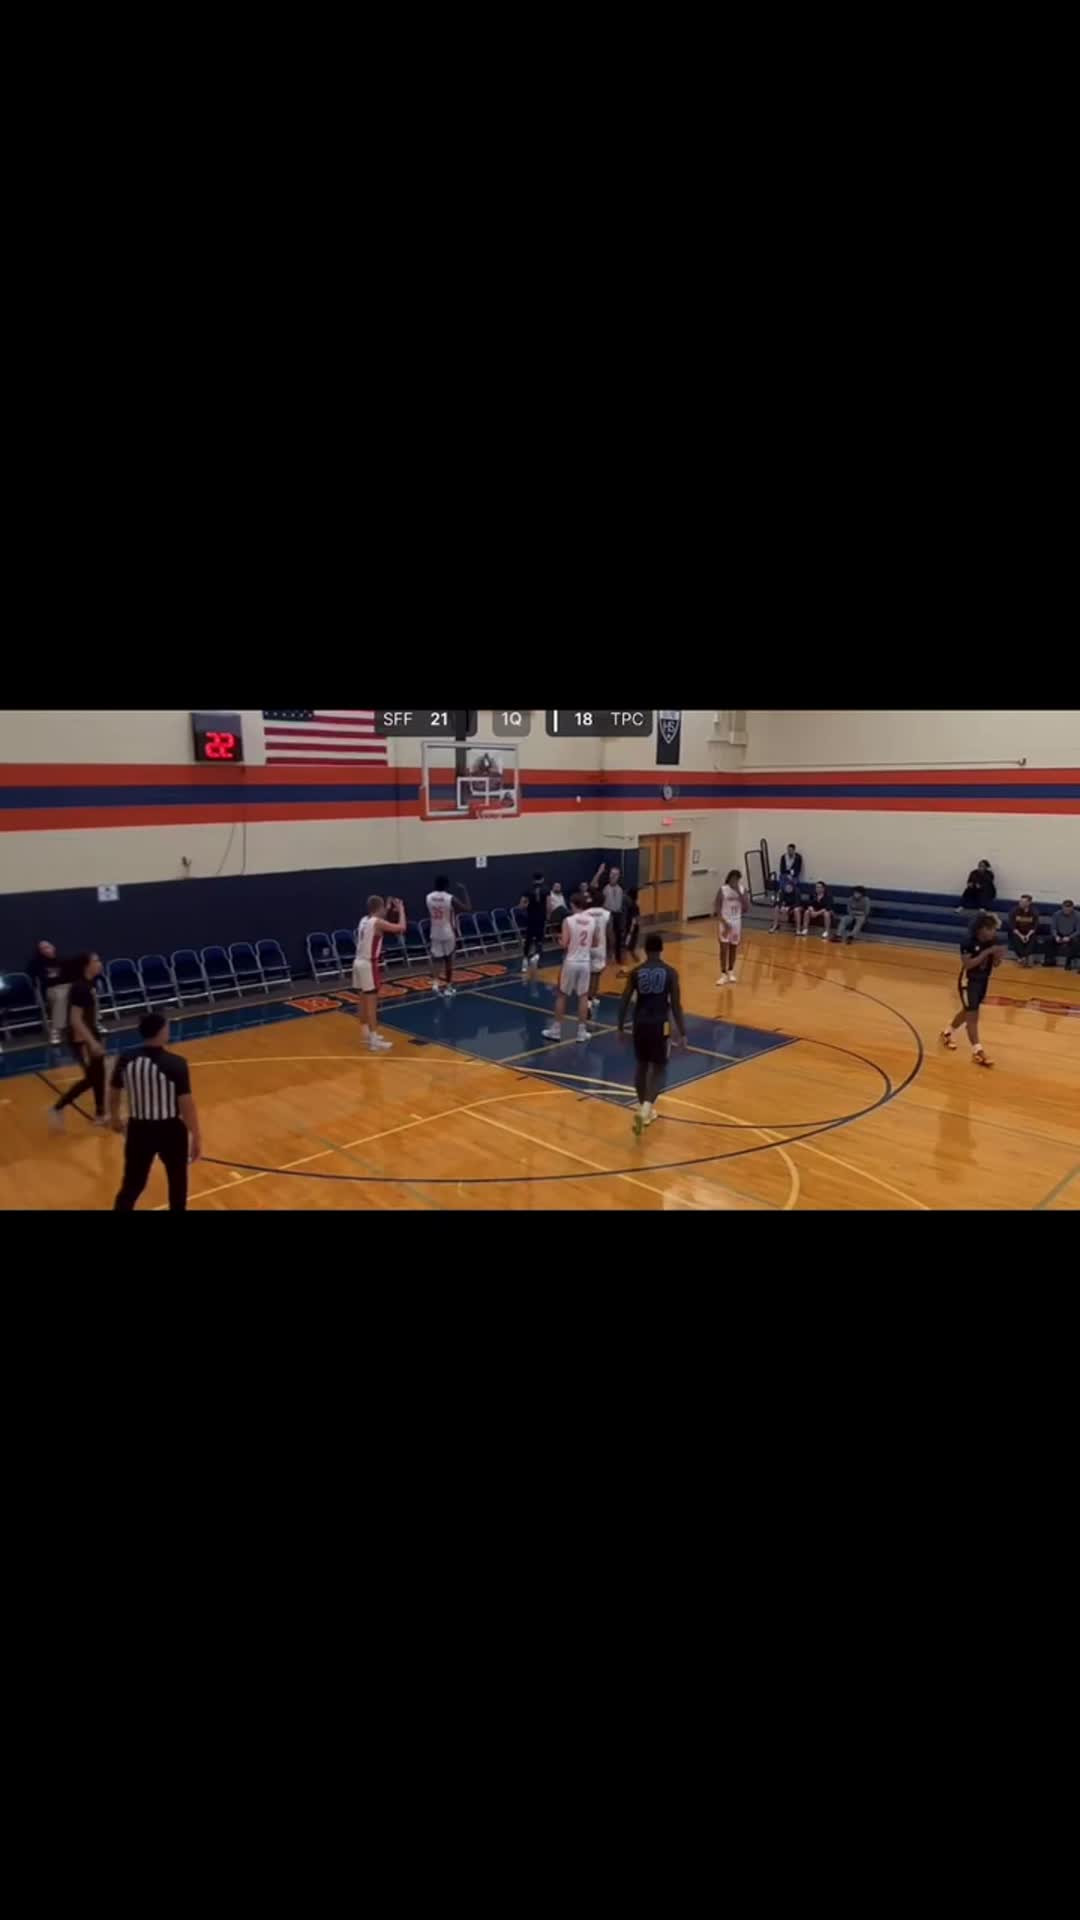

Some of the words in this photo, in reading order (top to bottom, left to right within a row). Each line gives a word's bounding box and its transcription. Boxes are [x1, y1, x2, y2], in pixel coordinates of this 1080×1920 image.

[205, 732, 234, 758] 22
[579, 930, 588, 947] 2
[638, 967, 667, 994] 20
